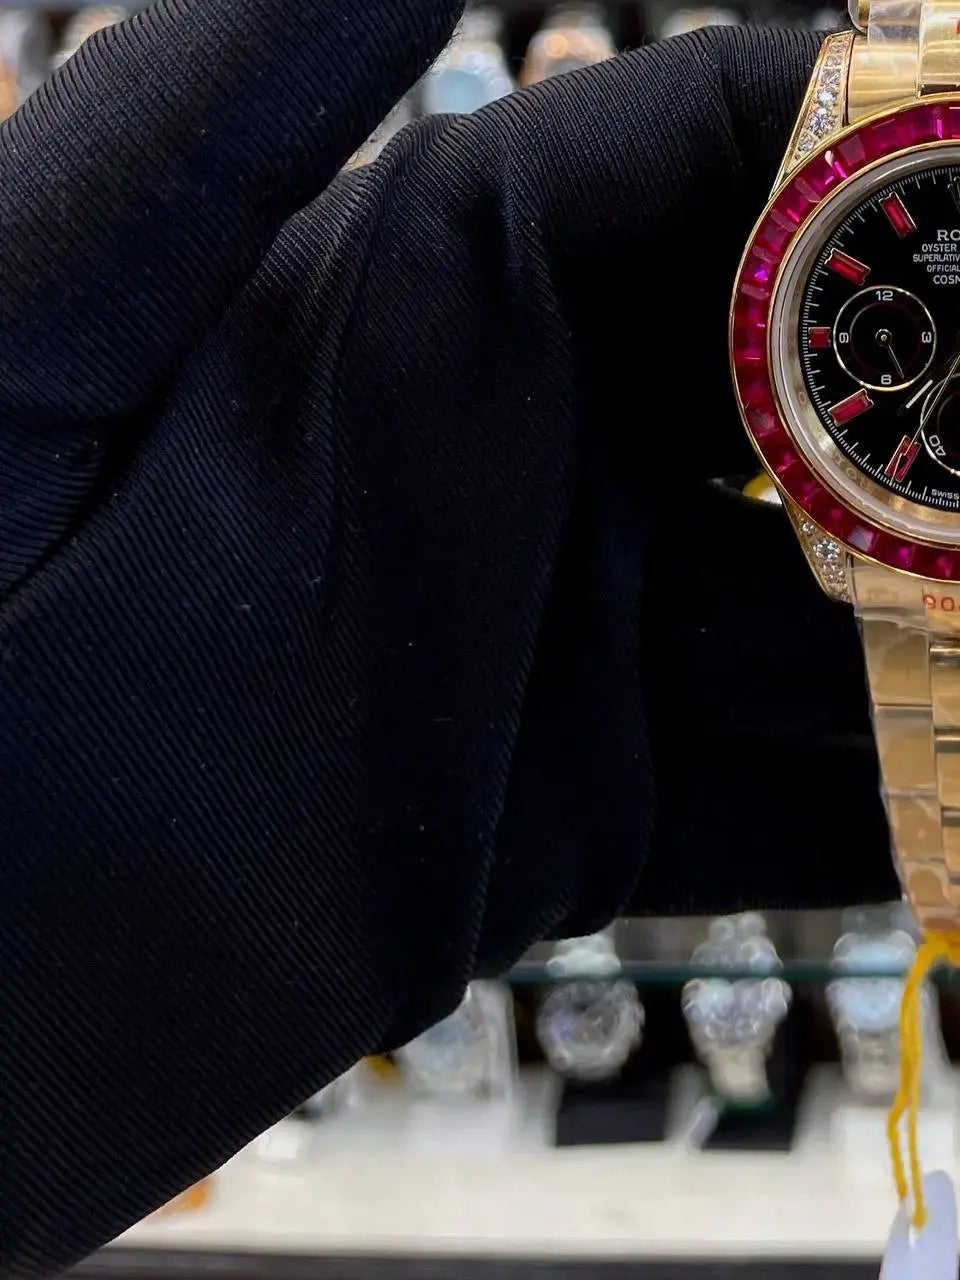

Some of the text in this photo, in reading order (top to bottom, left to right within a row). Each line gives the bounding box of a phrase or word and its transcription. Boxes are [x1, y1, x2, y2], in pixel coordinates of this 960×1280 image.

[921, 243, 957, 253] OYSTER
[875, 290, 894, 301] 12
[921, 331, 932, 343] 3
[928, 434, 947, 457] 40
[931, 488, 960, 500] SWISS
